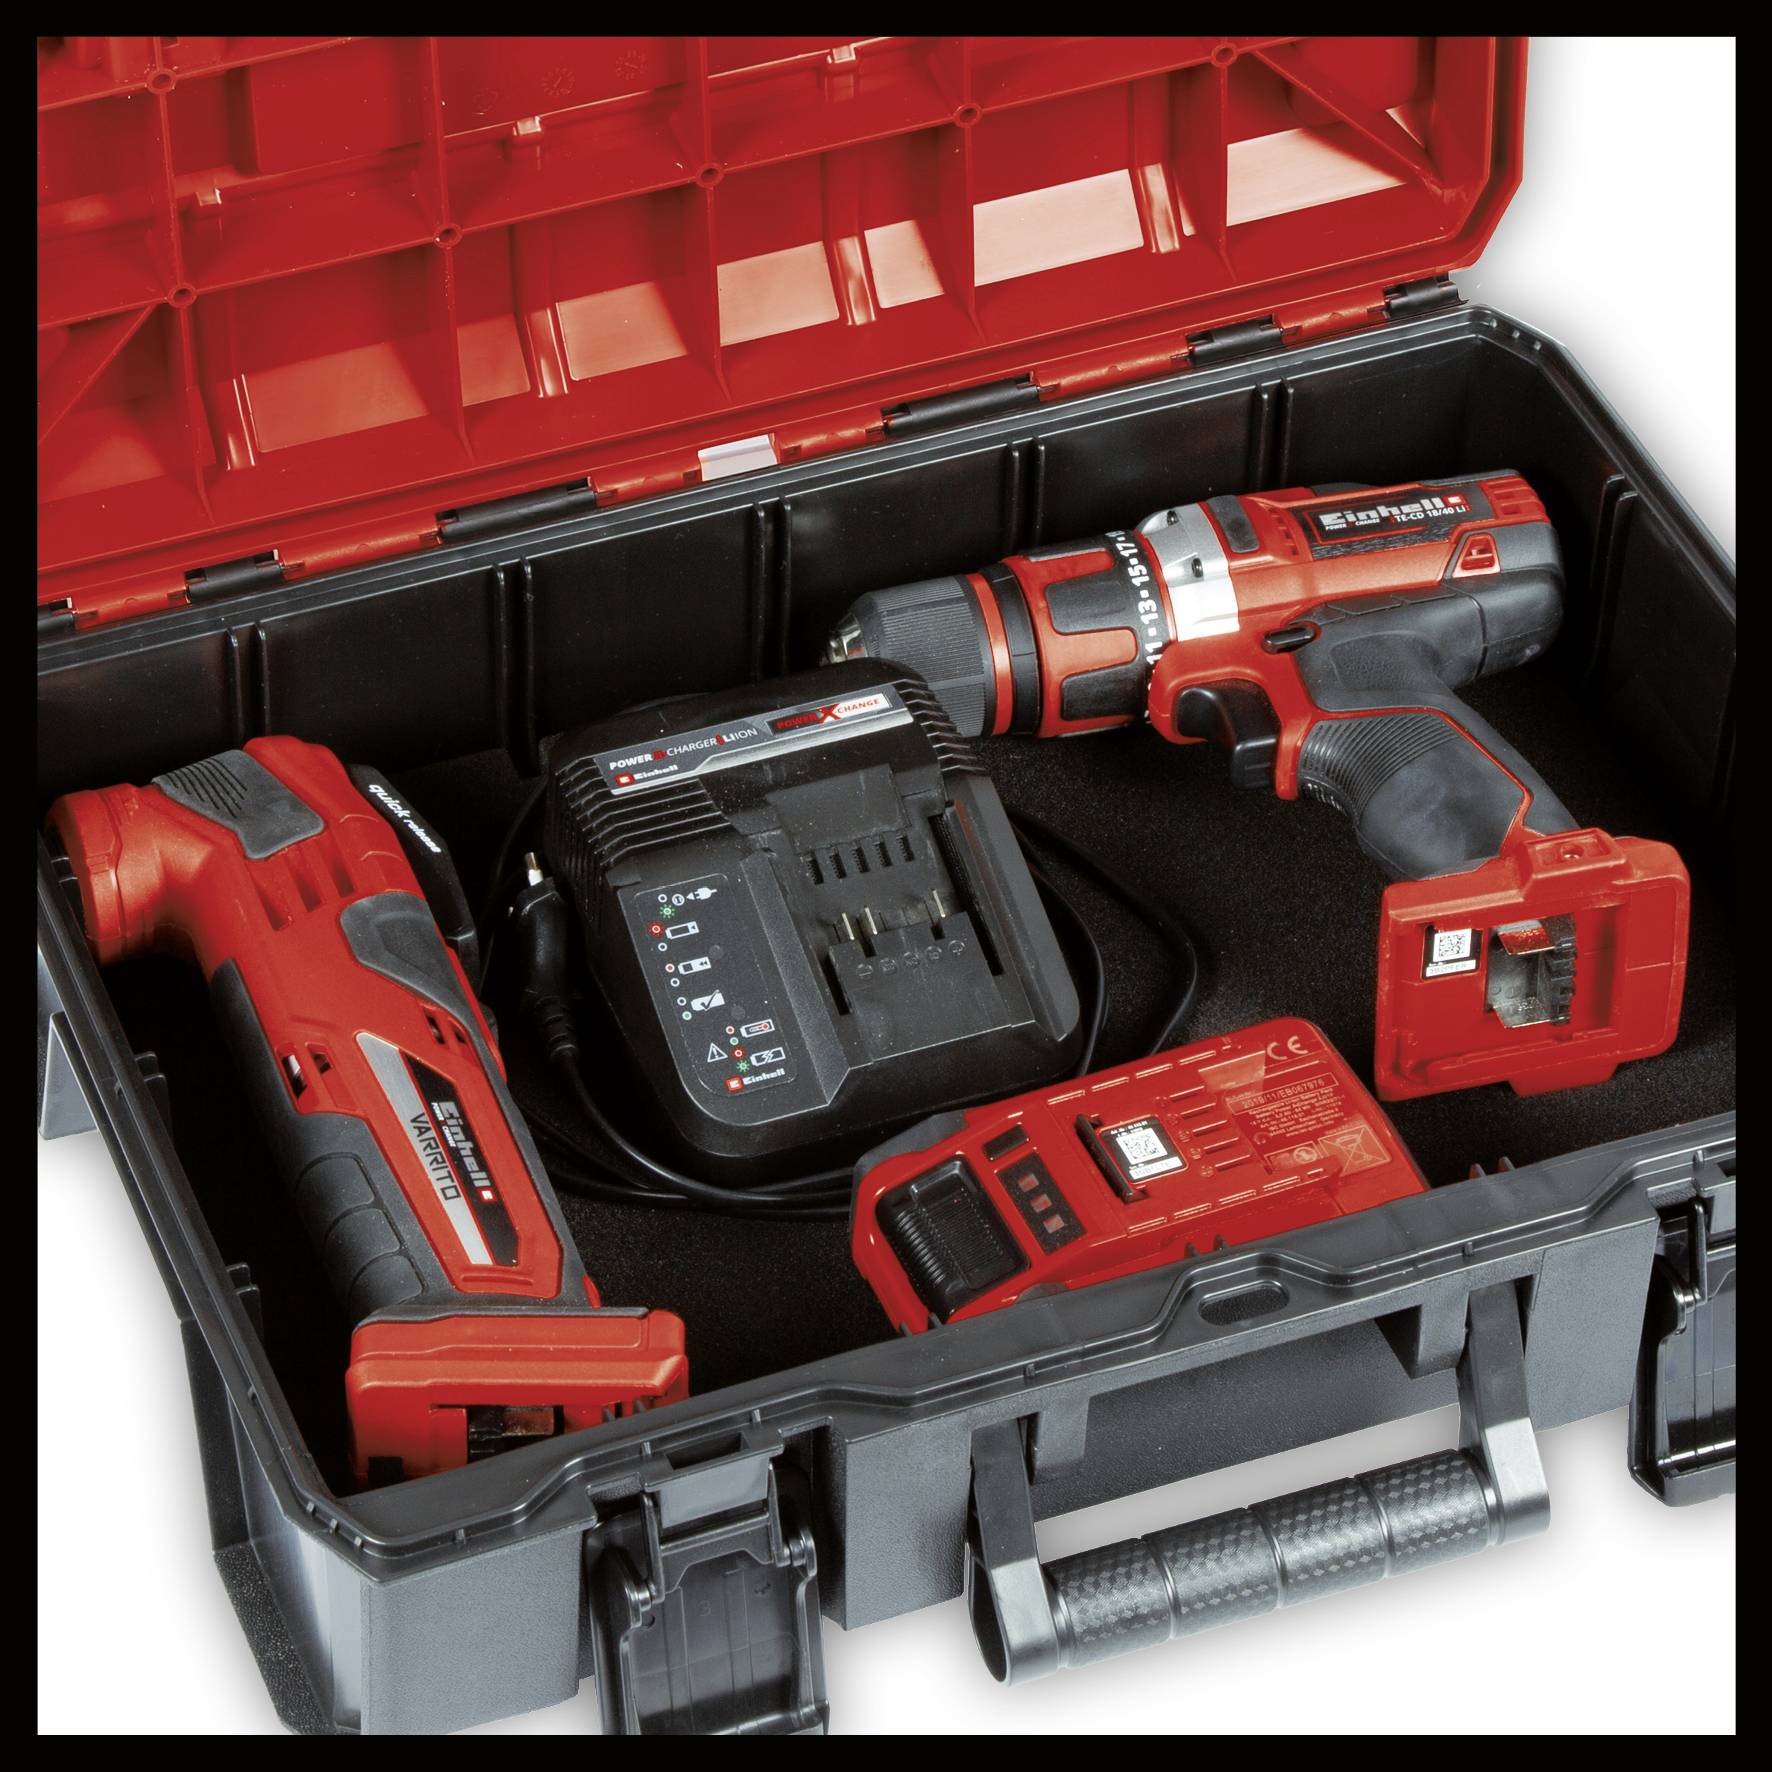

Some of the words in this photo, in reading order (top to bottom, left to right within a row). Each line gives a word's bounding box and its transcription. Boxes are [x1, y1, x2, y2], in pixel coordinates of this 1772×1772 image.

[1318, 497, 1445, 526] Einhell
[1395, 512, 1425, 523] TE-CD
[1426, 507, 1454, 518] 18/40
[1115, 542, 1139, 558] 17
[1127, 564, 1150, 587] 15
[1138, 599, 1159, 625] 13
[609, 752, 653, 770] POWER
[666, 738, 718, 757] CHARGER
[634, 764, 678, 780] Einhell
[368, 784, 411, 818] quick
[742, 1068, 786, 1085] Einhell
[410, 1112, 461, 1201] VARRITO
[438, 1101, 491, 1188] Einhell
